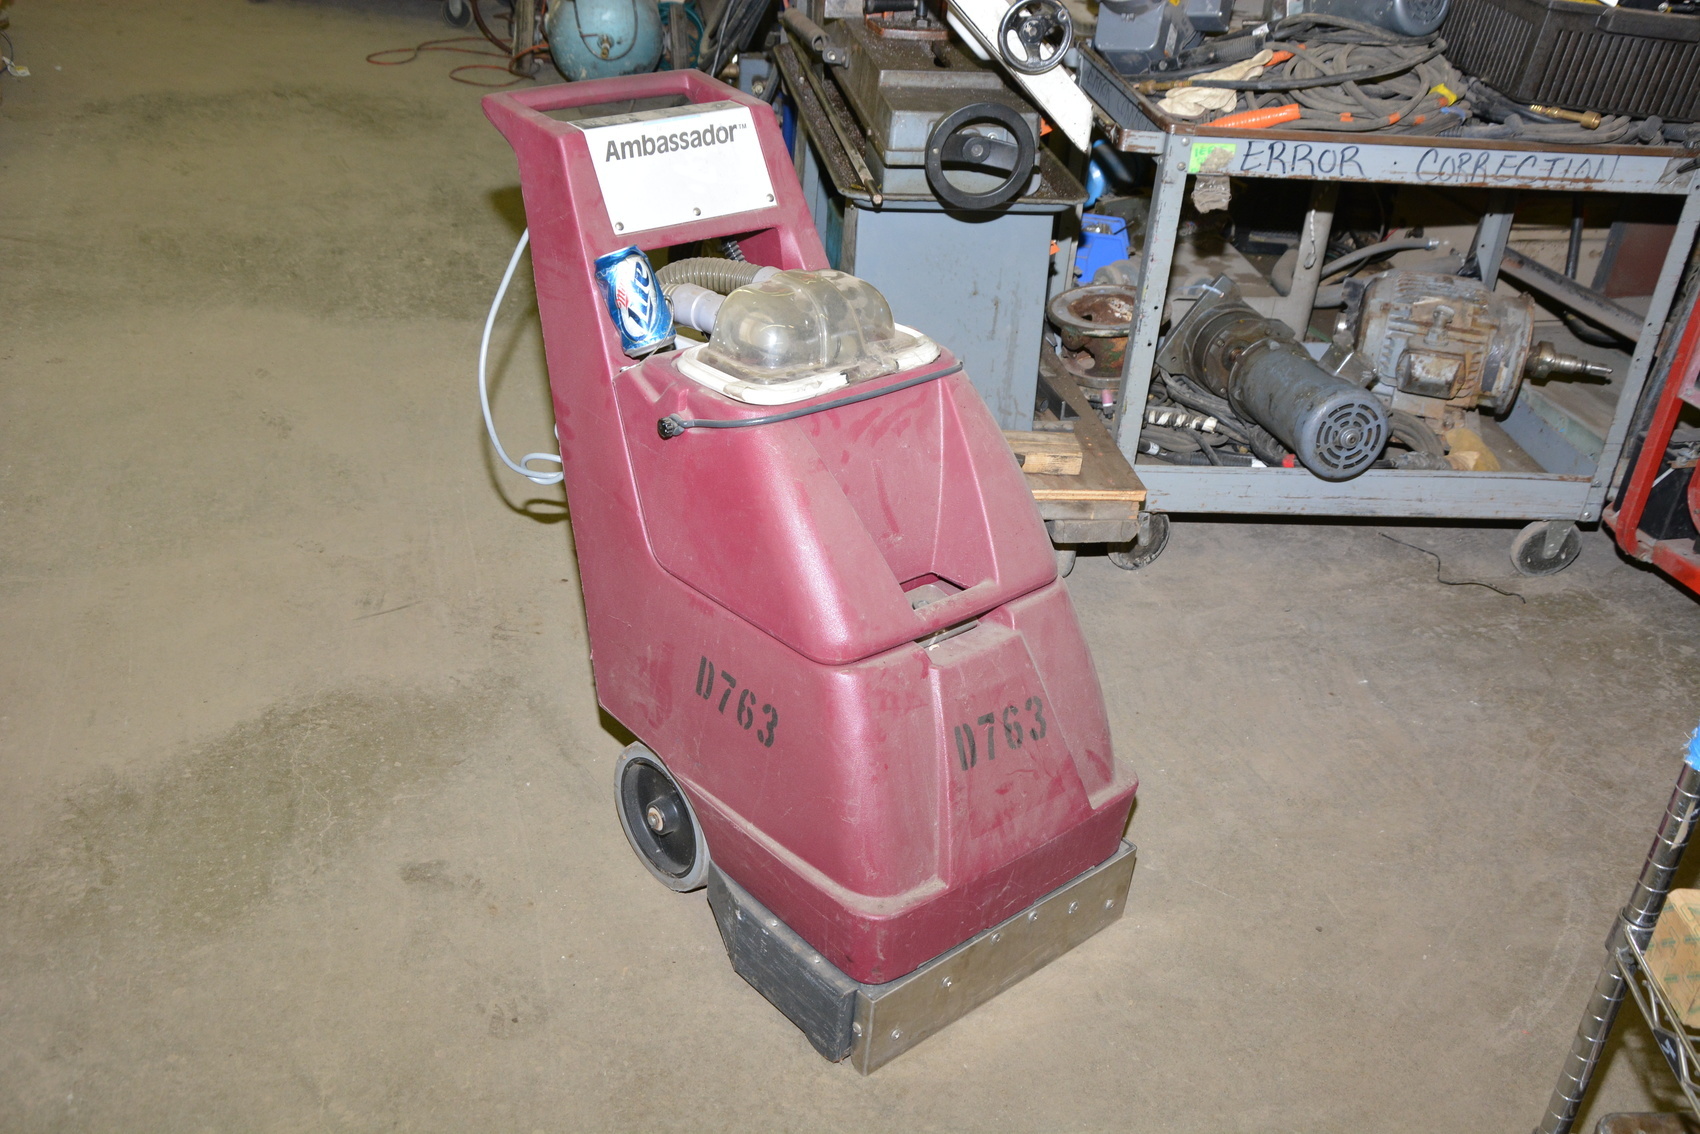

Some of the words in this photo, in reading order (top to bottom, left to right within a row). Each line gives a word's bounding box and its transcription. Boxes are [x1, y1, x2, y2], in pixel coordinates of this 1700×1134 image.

[605, 123, 737, 162] Ambassador
[1240, 140, 1365, 177] ERROR
[1416, 148, 1621, 186] CORRECTION
[696, 655, 779, 748] D763
[954, 695, 1047, 771] D763
